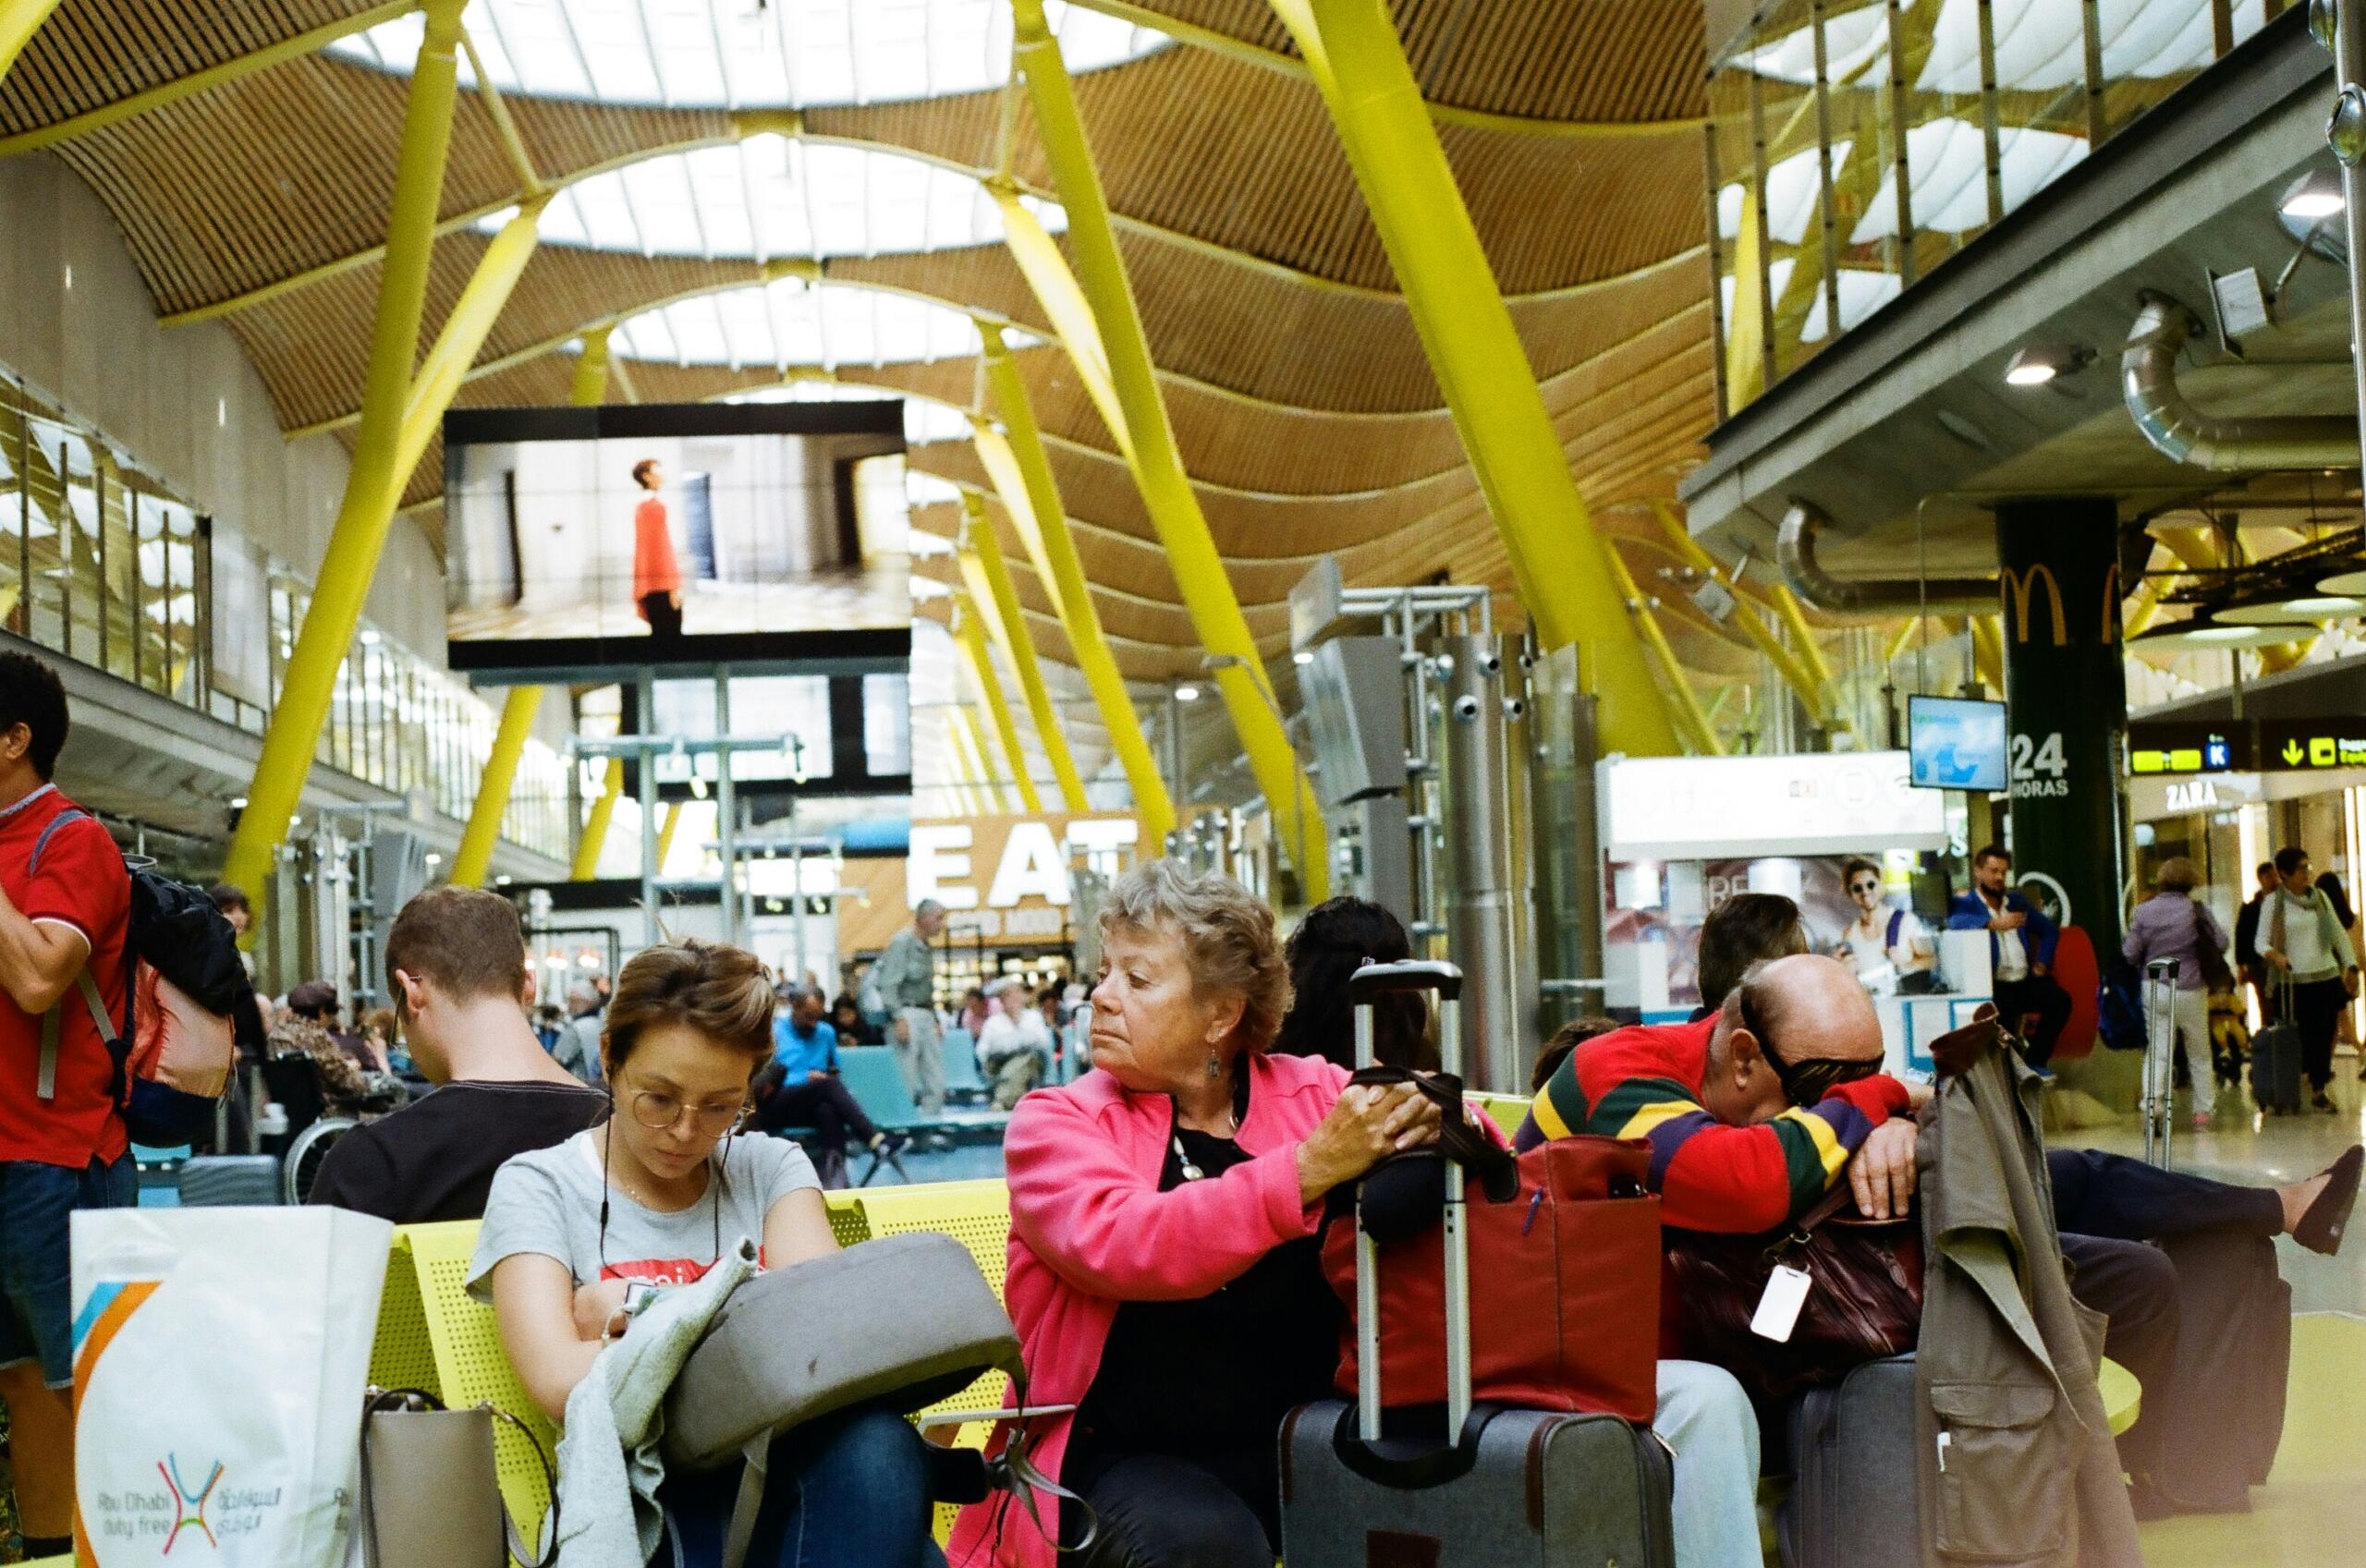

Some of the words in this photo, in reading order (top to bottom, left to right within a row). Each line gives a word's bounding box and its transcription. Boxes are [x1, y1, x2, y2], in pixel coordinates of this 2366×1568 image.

[2012, 732, 2068, 779] 24
[2012, 779, 2069, 797] HORAS
[2165, 781, 2218, 811] ZARA
[906, 820, 1139, 910] EAT
[125, 1490, 170, 1512] Dhabi
[140, 1514, 171, 1535] free
